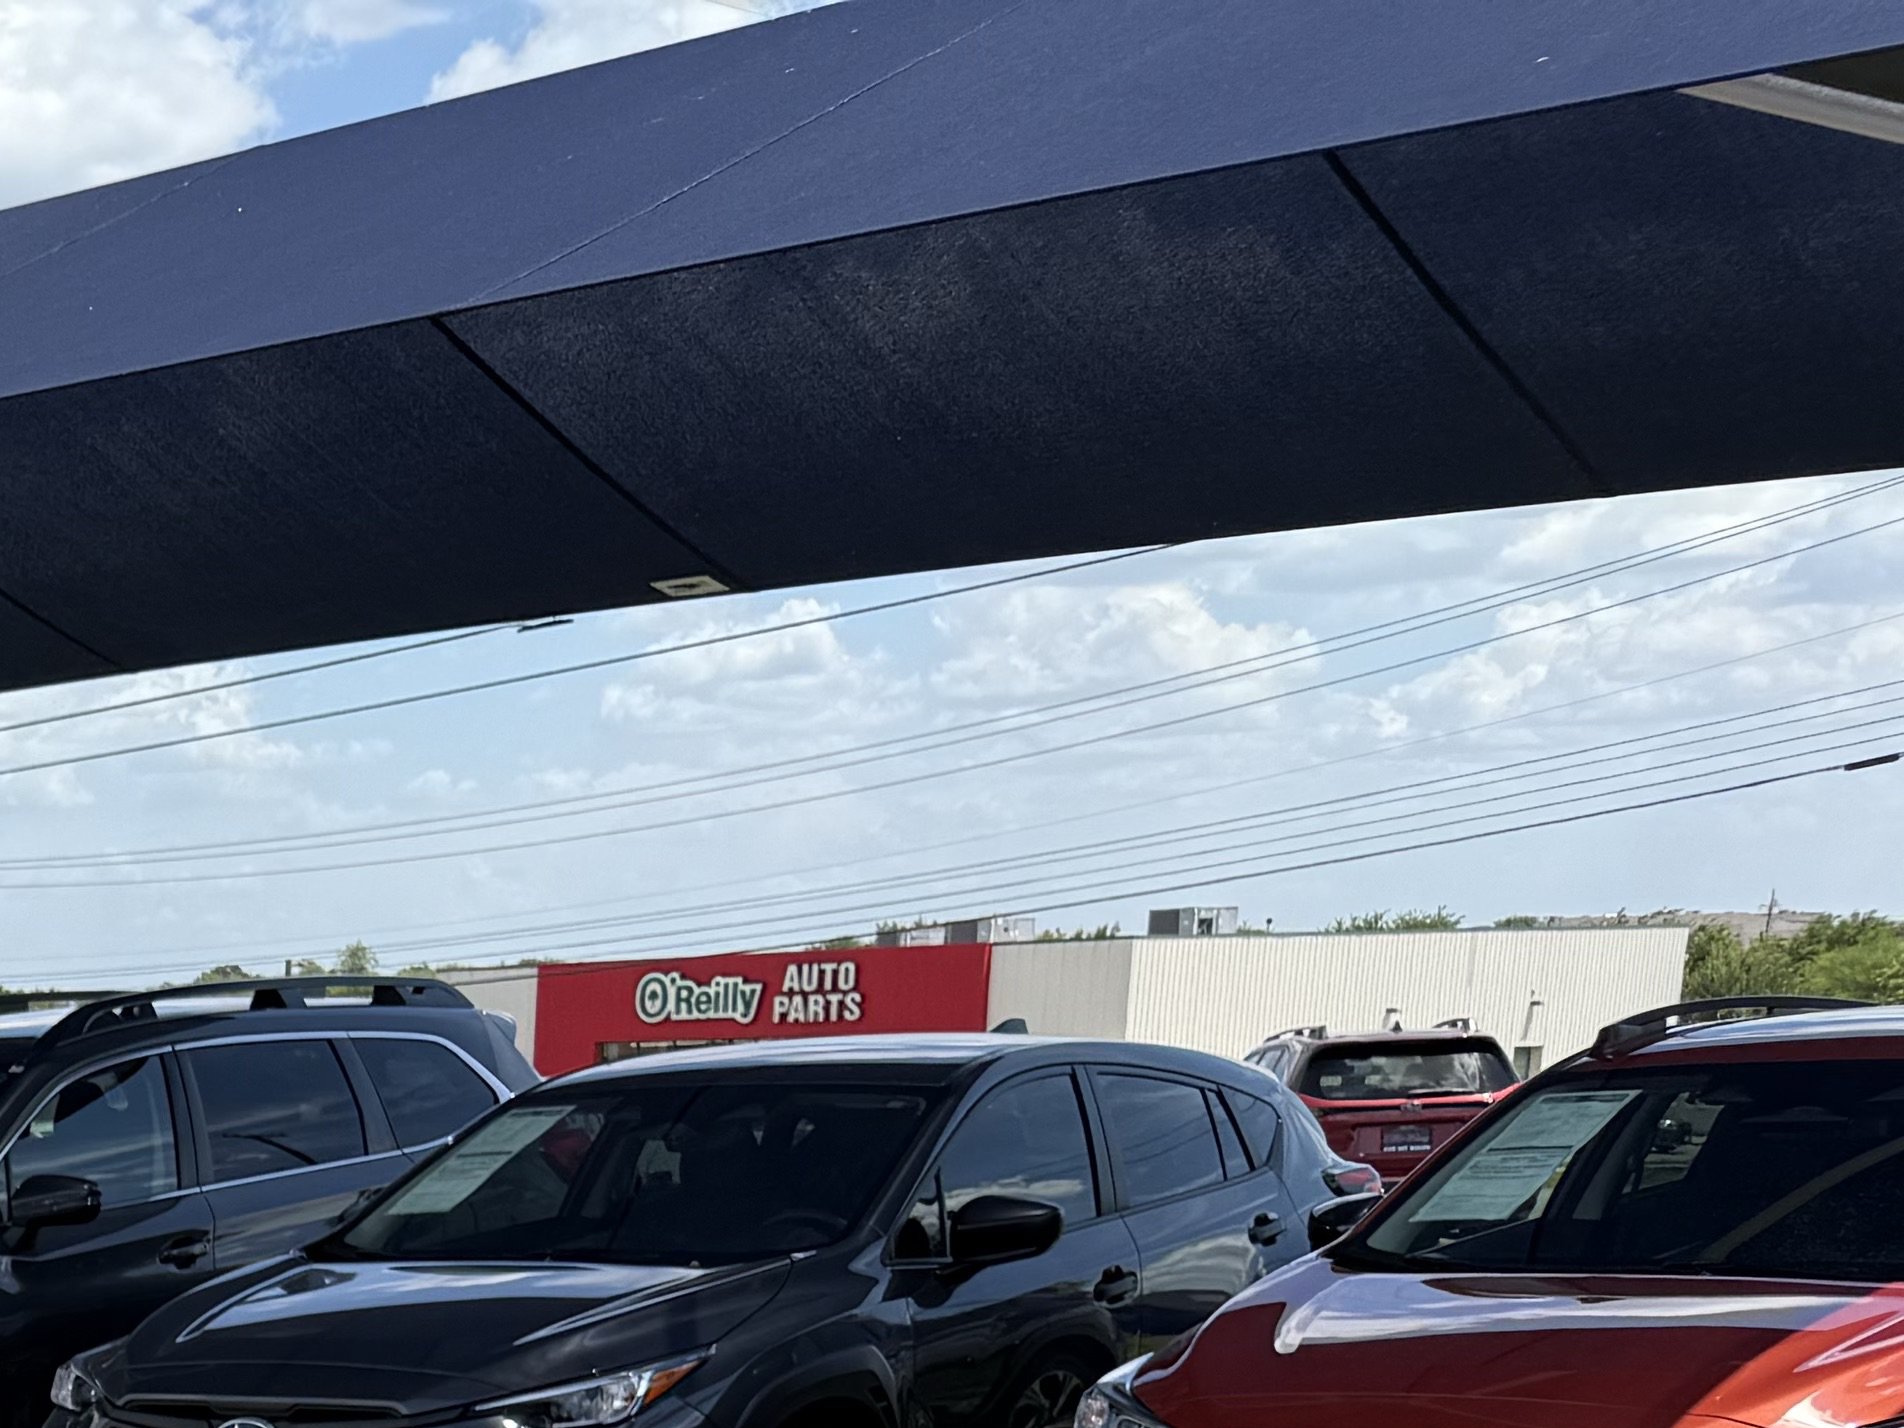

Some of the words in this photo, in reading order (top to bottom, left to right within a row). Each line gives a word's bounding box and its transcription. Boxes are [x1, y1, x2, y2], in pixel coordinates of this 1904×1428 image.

[638, 974, 760, 1022] O'Reilly
[782, 962, 856, 992] AUTO
[772, 992, 862, 1024] PARTS
